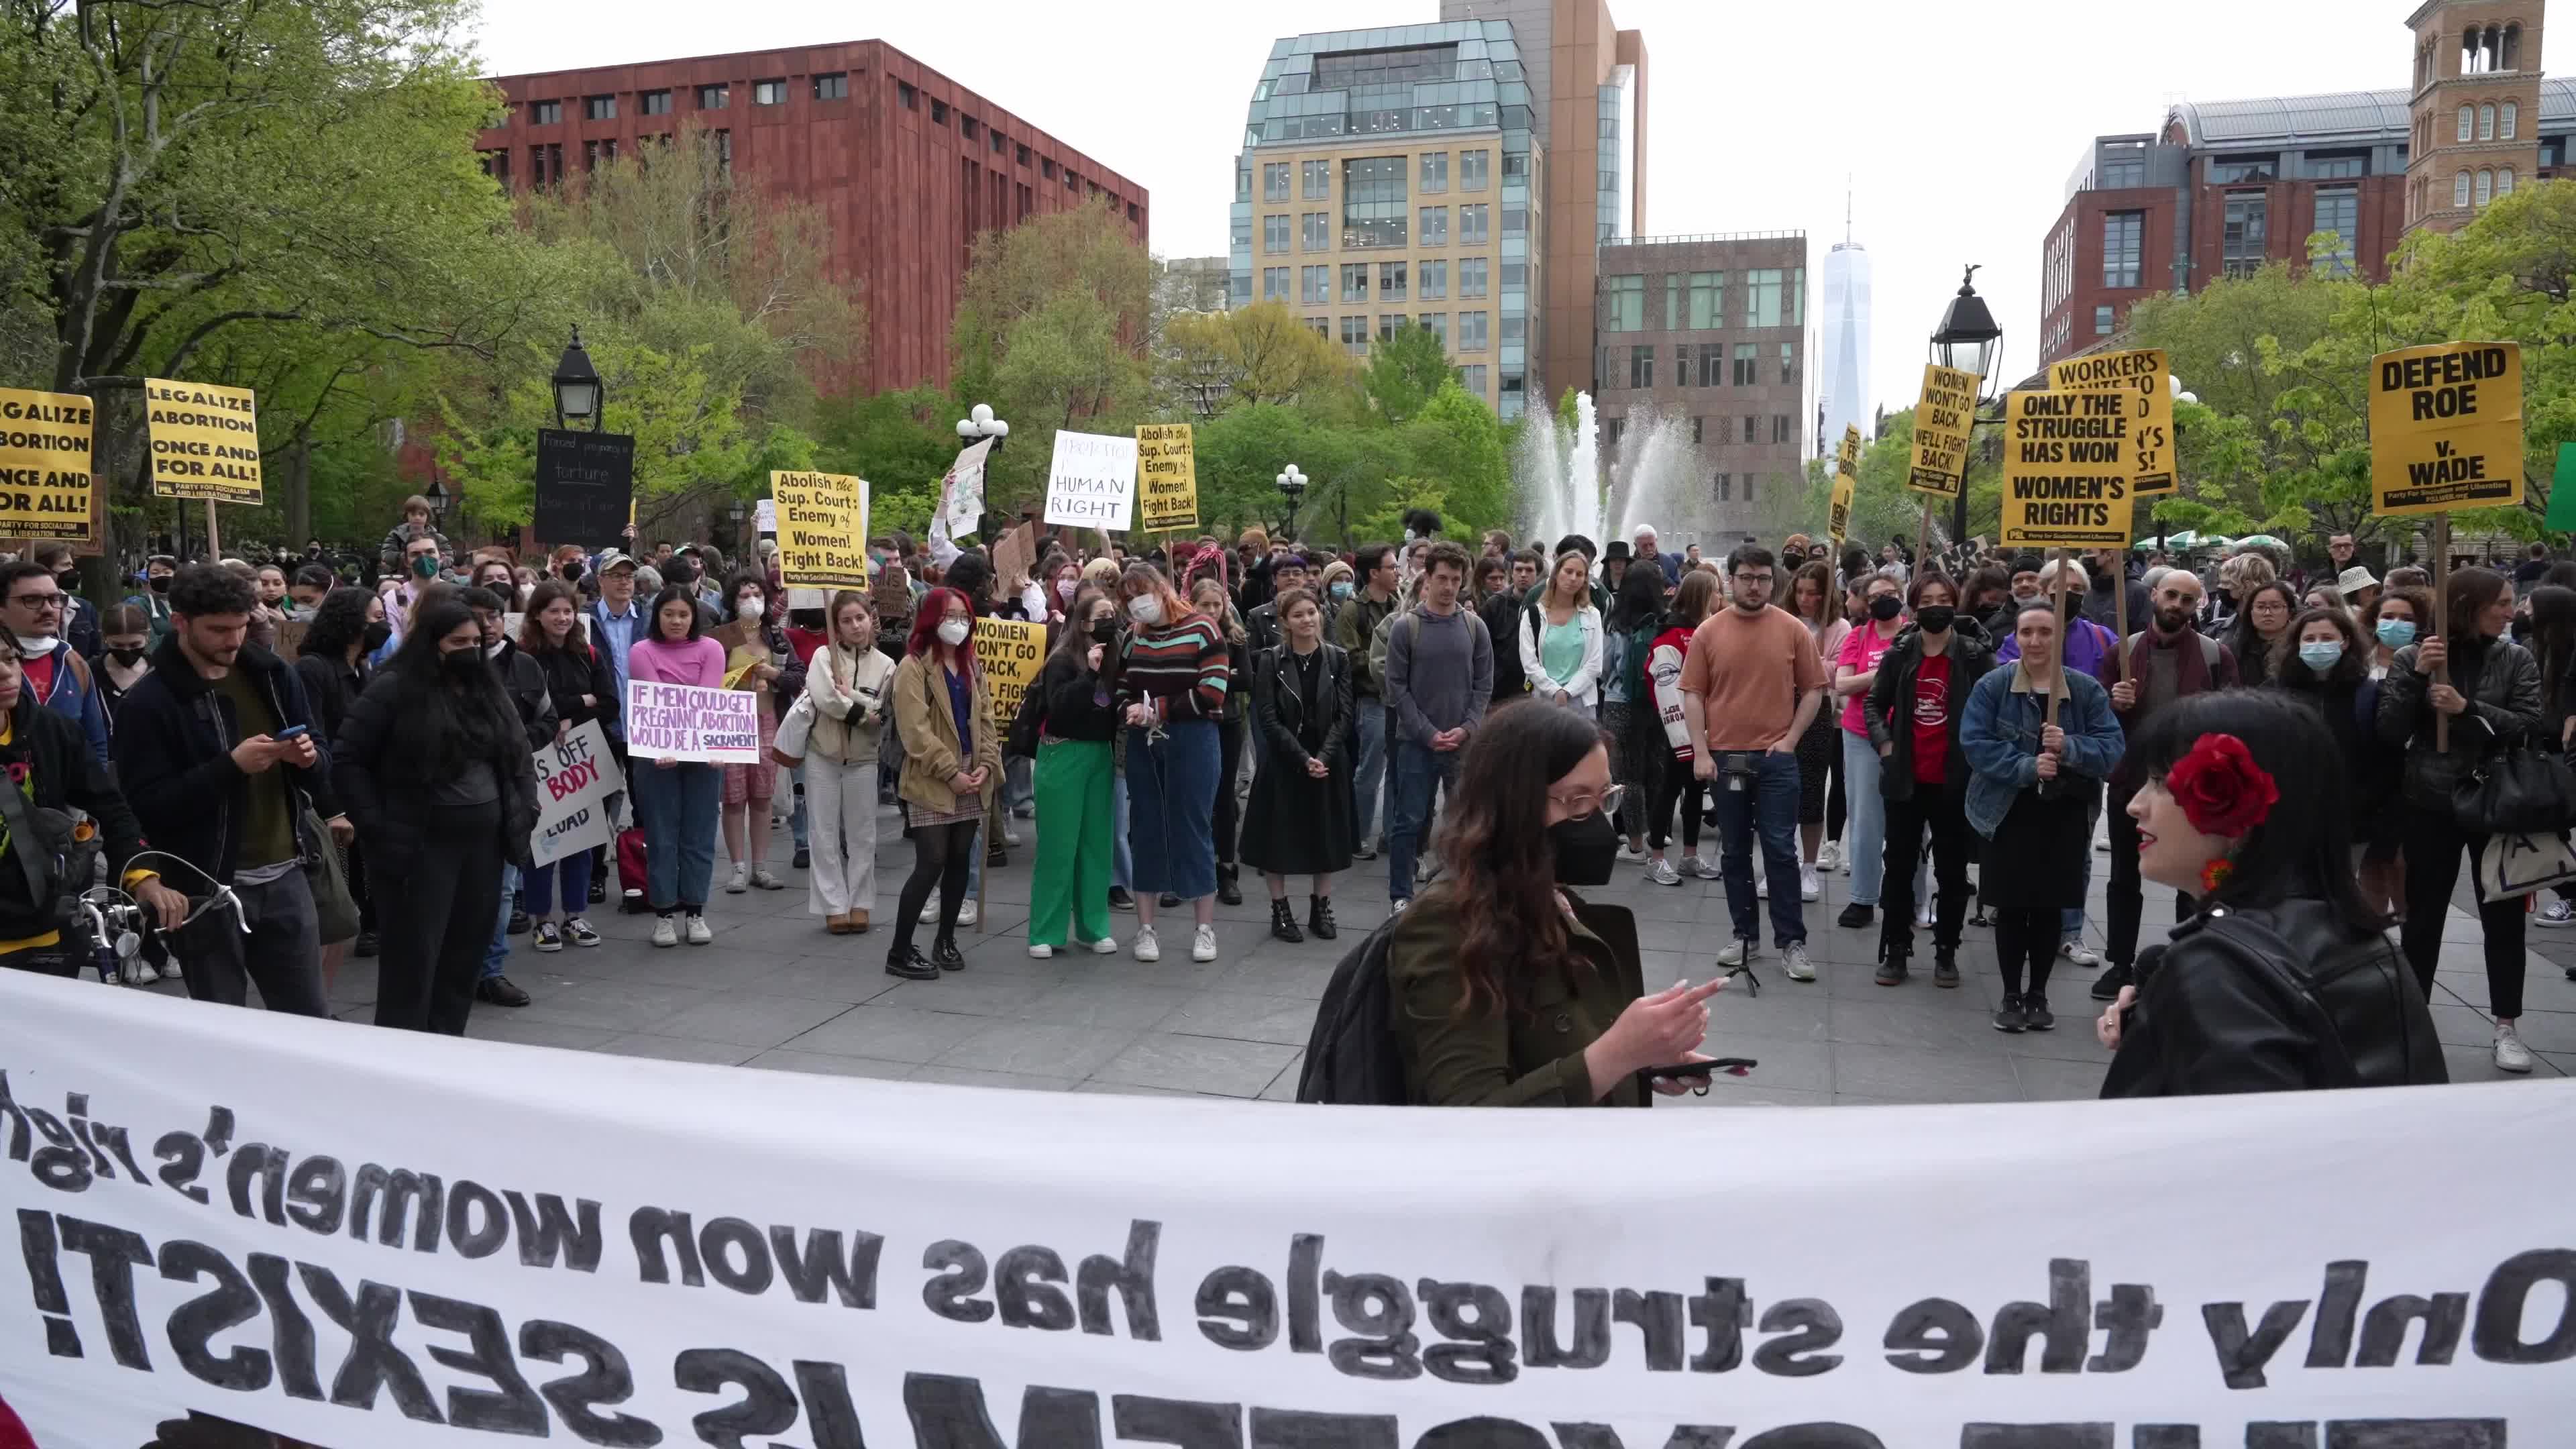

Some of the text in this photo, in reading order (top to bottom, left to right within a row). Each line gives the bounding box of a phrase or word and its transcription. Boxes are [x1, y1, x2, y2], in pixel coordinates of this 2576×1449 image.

[2058, 352, 2158, 384] WORKERS
[2382, 348, 2506, 392] DEFEND
[1934, 370, 1969, 392] WOMEN
[2128, 375, 2154, 395] TO
[148, 387, 252, 413] LEGALIZE
[1926, 388, 1970, 413] WON'T GO
[2023, 394, 2078, 416] ONLY
[2082, 394, 2123, 415] THE
[2412, 384, 2477, 421] ROE
[0, 402, 90, 424] GALIZE
[150, 411, 254, 433] ABORTION
[1932, 409, 1960, 430] BACK,
[1141, 427, 1173, 440] Abolish
[2016, 417, 2127, 439] STRUGGLE
[0, 431, 89, 452] BORTION
[152, 440, 258, 461] ONCE AND
[1916, 429, 1966, 453] WE'LL FIGHT
[1139, 444, 1161, 460] Sup.
[1921, 449, 1955, 471] BACK!
[2021, 441, 2063, 463] HAS
[2069, 441, 2118, 463] WON
[157, 459, 258, 482] FOR ALL!
[554, 461, 608, 482] torture
[1146, 460, 1177, 474] Enemy
[2408, 455, 2485, 486] WADE
[0, 469, 90, 488] NCE AND
[780, 474, 853, 492] Abolish the
[1057, 476, 1124, 494] HUMAN
[1149, 478, 1187, 494] Women!
[2012, 476, 2125, 500] WOMEN'S
[2470, 482, 2508, 490] Liberation
[193, 490, 231, 500] LIBERATION
[216, 485, 250, 494] SOCIALISM
[777, 490, 810, 507] Sup.
[0, 492, 87, 513] OR ALL!
[1052, 497, 1121, 519] RIGHT
[1144, 495, 1193, 515] Fight Back!
[788, 507, 836, 527] Enemy
[840, 511, 851, 528] of
[2024, 502, 2109, 526] RIGHTS
[14, 529, 56, 537] LIBERATION
[40, 522, 77, 531] SOCIALISM
[792, 531, 851, 549] Women!
[783, 551, 863, 570] Fight Back!
[976, 622, 1029, 641] WOMEN
[974, 640, 1036, 660] ON'T GO
[633, 685, 753, 713] IF MEN COULD GET
[700, 712, 755, 733] ABORTION
[629, 726, 757, 751] WOULD BE A SACRAMENT
[557, 735, 588, 767] OFF
[547, 754, 600, 802] BODY
